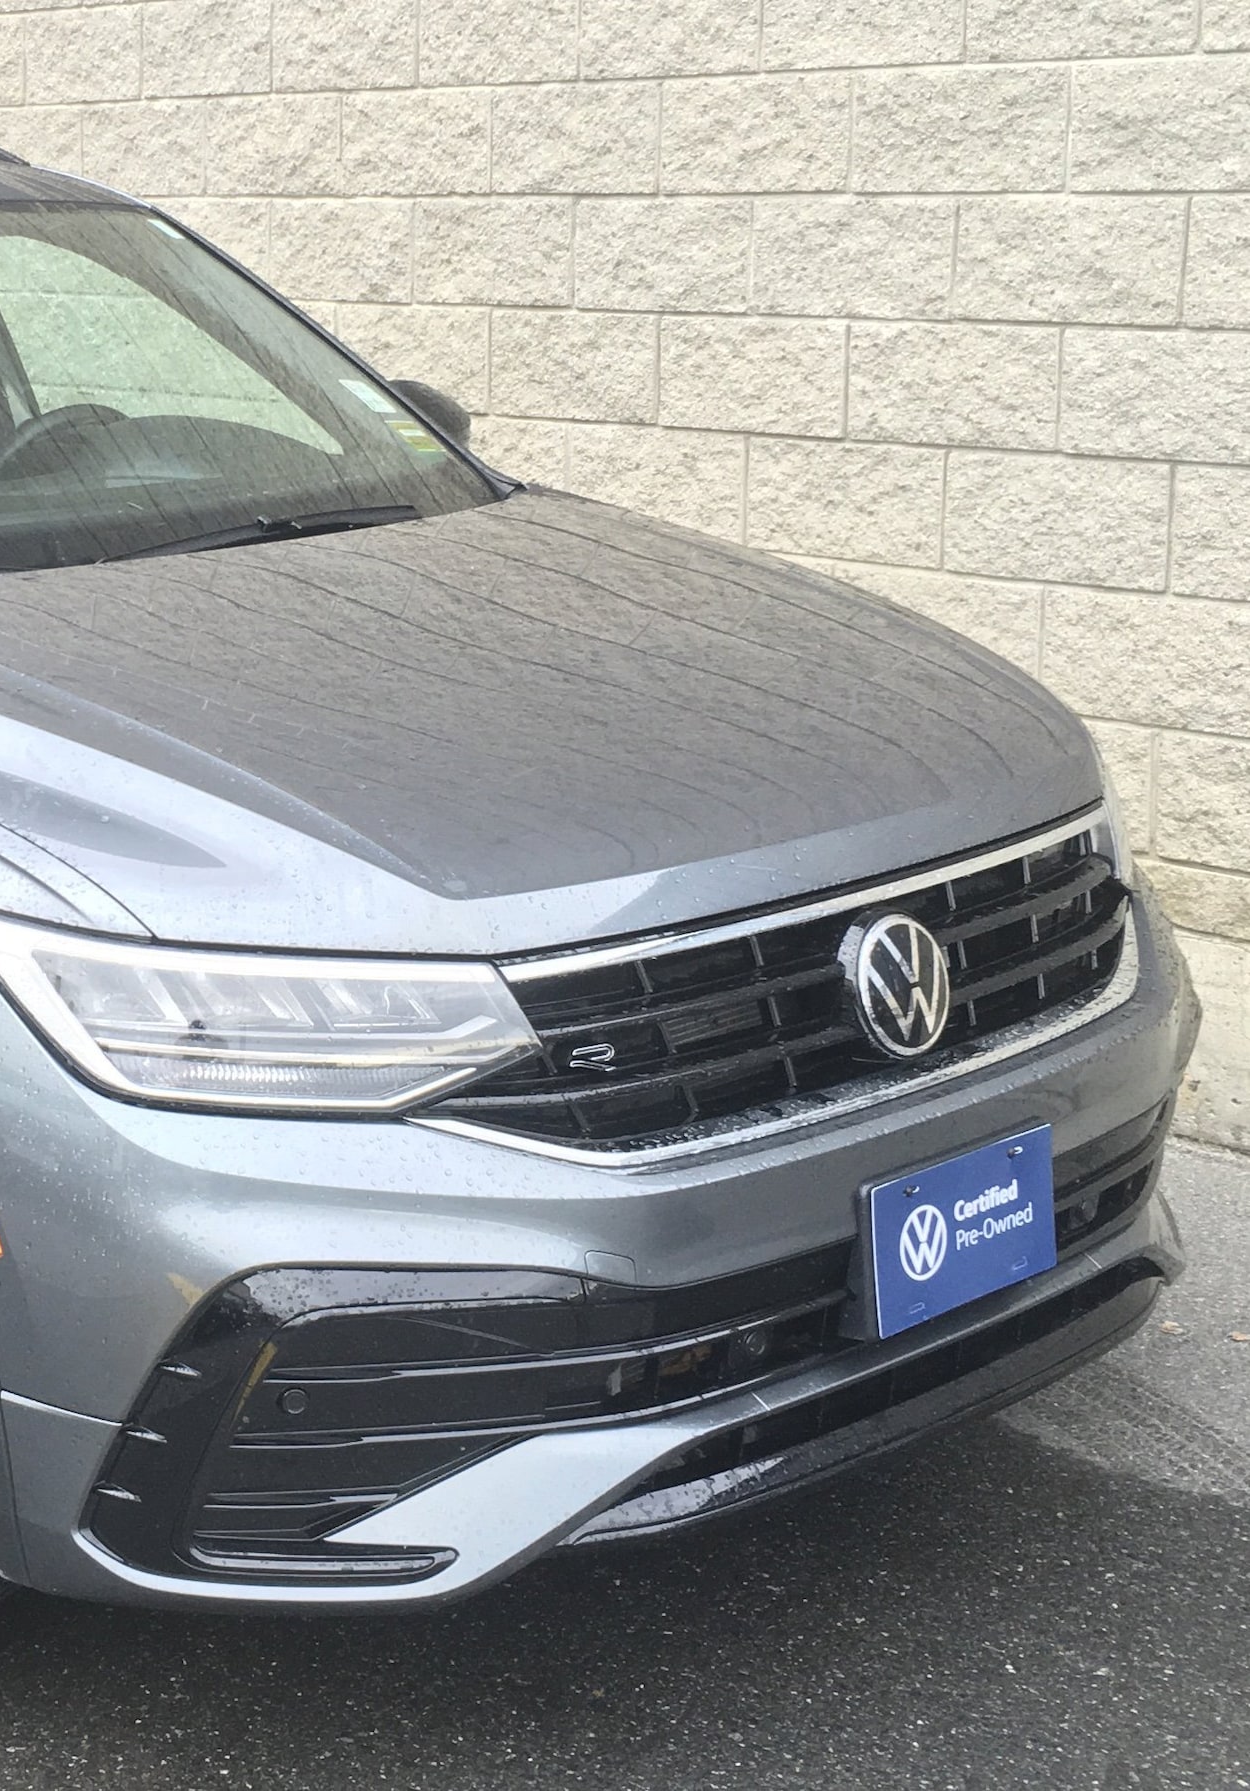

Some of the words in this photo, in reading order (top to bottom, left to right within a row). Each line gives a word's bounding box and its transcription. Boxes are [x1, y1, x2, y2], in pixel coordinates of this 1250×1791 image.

[858, 914, 949, 1055] VW
[953, 1179, 1018, 1221] Certified
[956, 1202, 1033, 1250] Pre-Owned
[900, 1204, 947, 1281] VW
